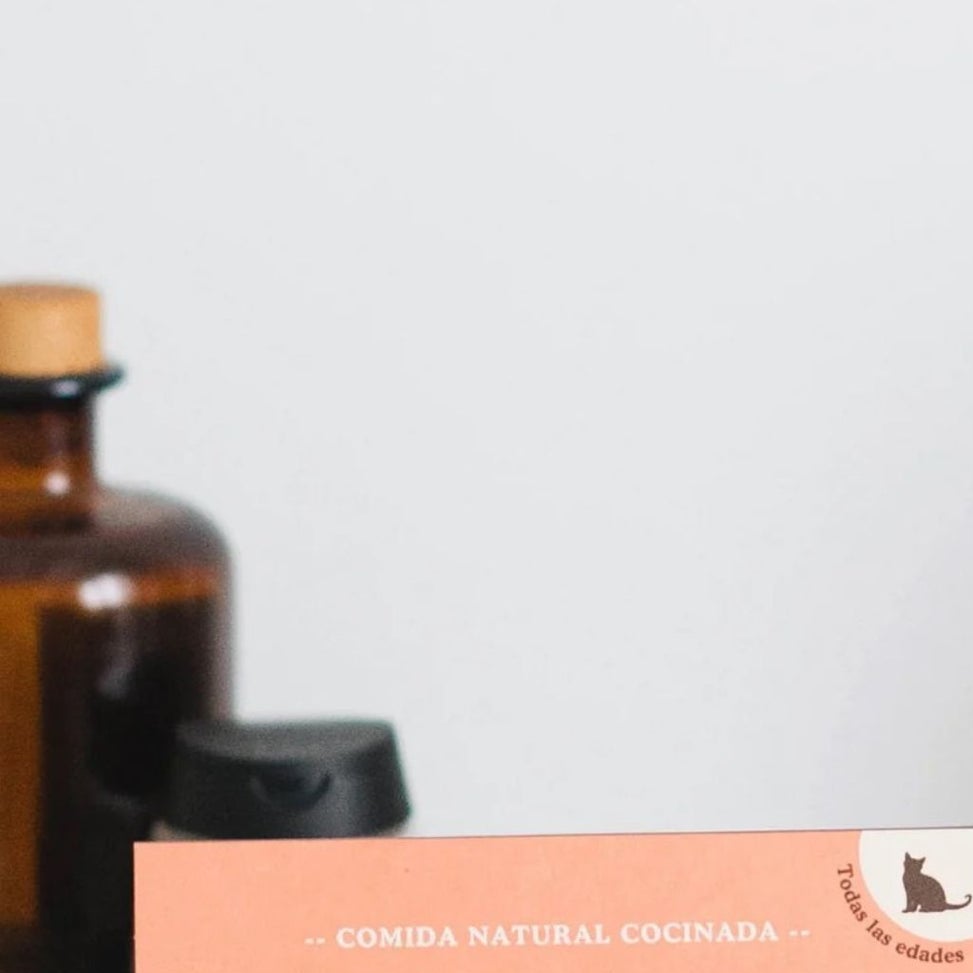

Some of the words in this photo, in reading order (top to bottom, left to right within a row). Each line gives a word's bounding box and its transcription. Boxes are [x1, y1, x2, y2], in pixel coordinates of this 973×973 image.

[336, 926, 458, 949] COMIDA
[467, 923, 611, 946] NATURAL
[619, 920, 779, 945] COCINADA
[837, 863, 868, 922] Todas
[866, 919, 892, 946] las
[895, 941, 965, 964] edades
